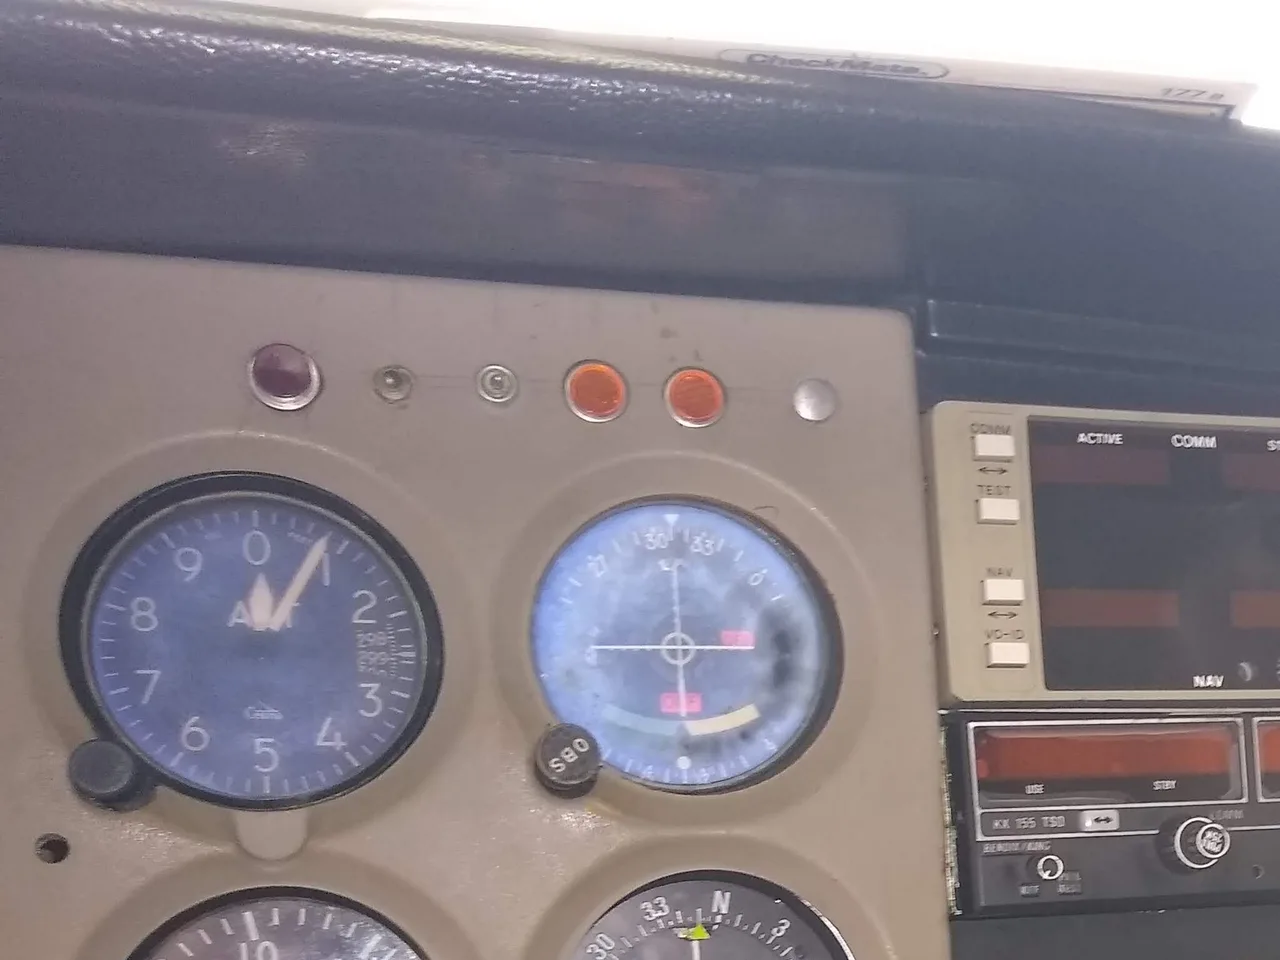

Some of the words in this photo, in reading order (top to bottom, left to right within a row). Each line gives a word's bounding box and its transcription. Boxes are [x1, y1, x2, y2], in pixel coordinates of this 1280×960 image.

[1076, 432, 1124, 445] ACTIVE
[1170, 434, 1217, 449] COMM
[174, 546, 204, 582] 9
[242, 530, 272, 566] 0
[130, 596, 159, 632] 8
[352, 590, 378, 624] 2
[136, 669, 161, 704] 7
[1193, 674, 1224, 688] NAV
[359, 683, 382, 718] 3
[180, 715, 212, 751] 6
[315, 716, 348, 748] 4
[254, 737, 279, 773] 5
[639, 896, 671, 922] 33
[711, 890, 732, 914] N
[771, 918, 792, 941] 3
